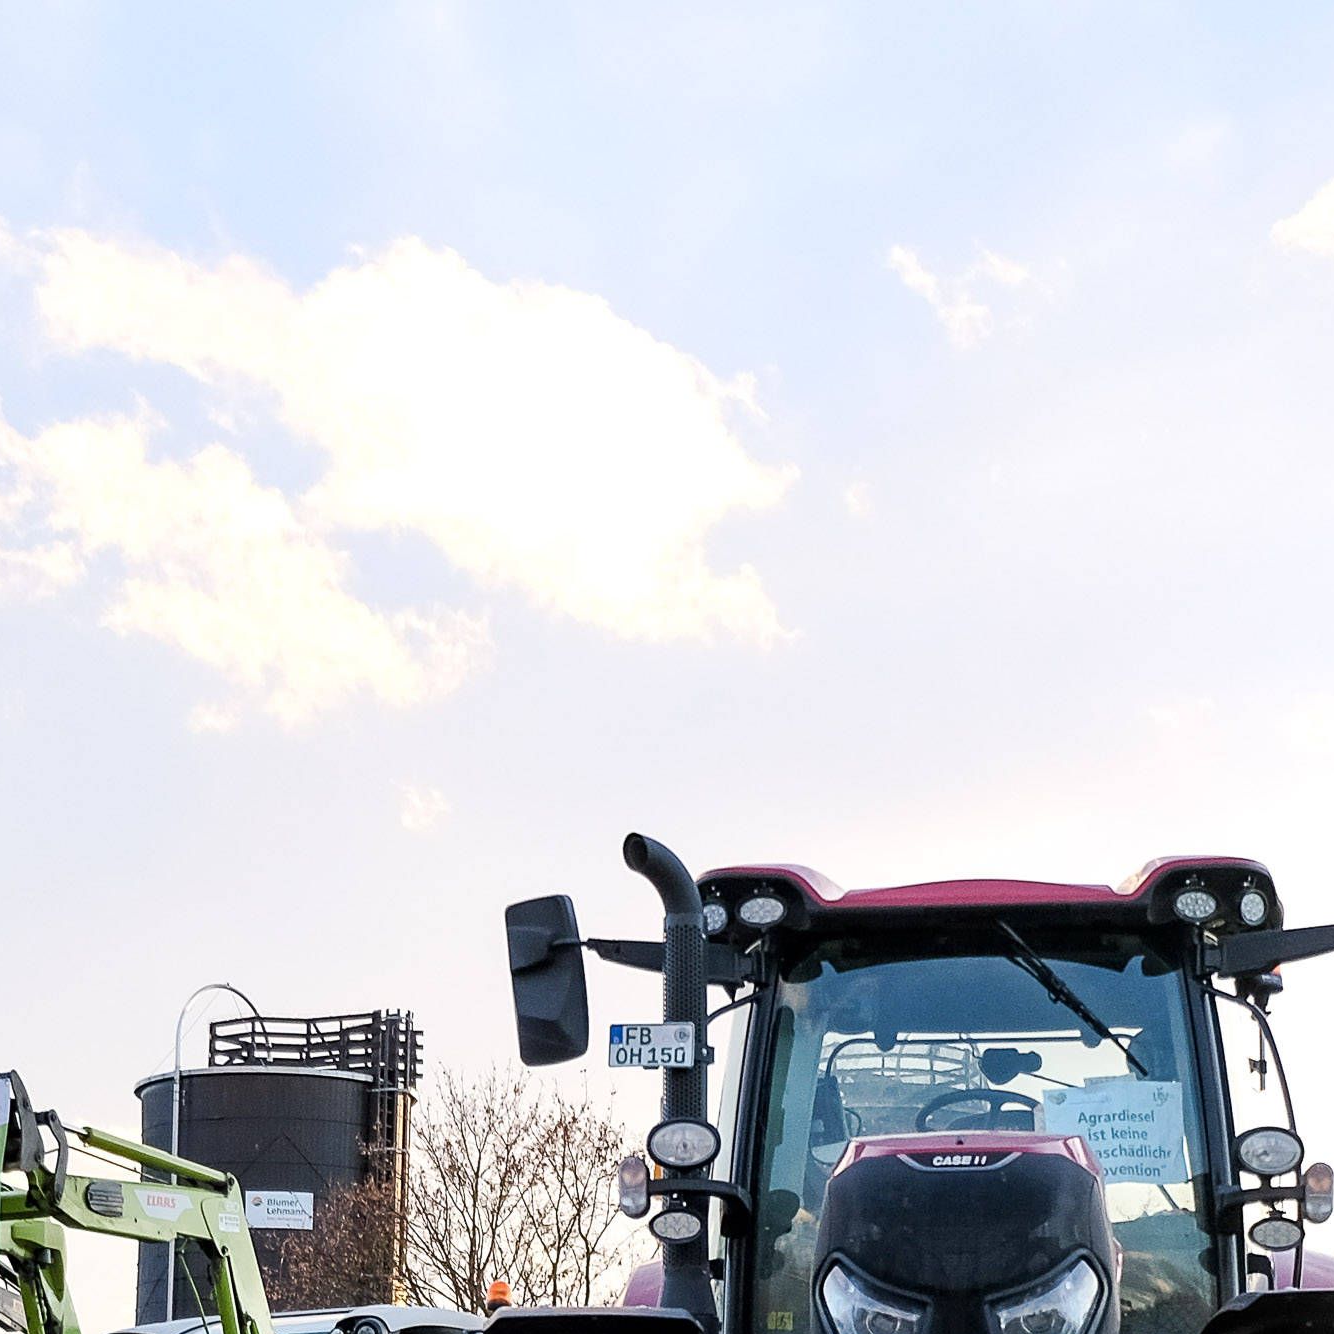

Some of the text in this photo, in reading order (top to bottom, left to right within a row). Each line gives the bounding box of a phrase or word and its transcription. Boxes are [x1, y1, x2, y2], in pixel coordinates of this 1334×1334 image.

[626, 1027, 651, 1045] FB
[616, 1046, 686, 1065] OH 150
[1078, 1110, 1155, 1127] Agrardiesel
[1088, 1127, 1148, 1141] ist keine
[932, 1155, 972, 1167] CASE
[146, 1194, 177, 1209] CLAAS
